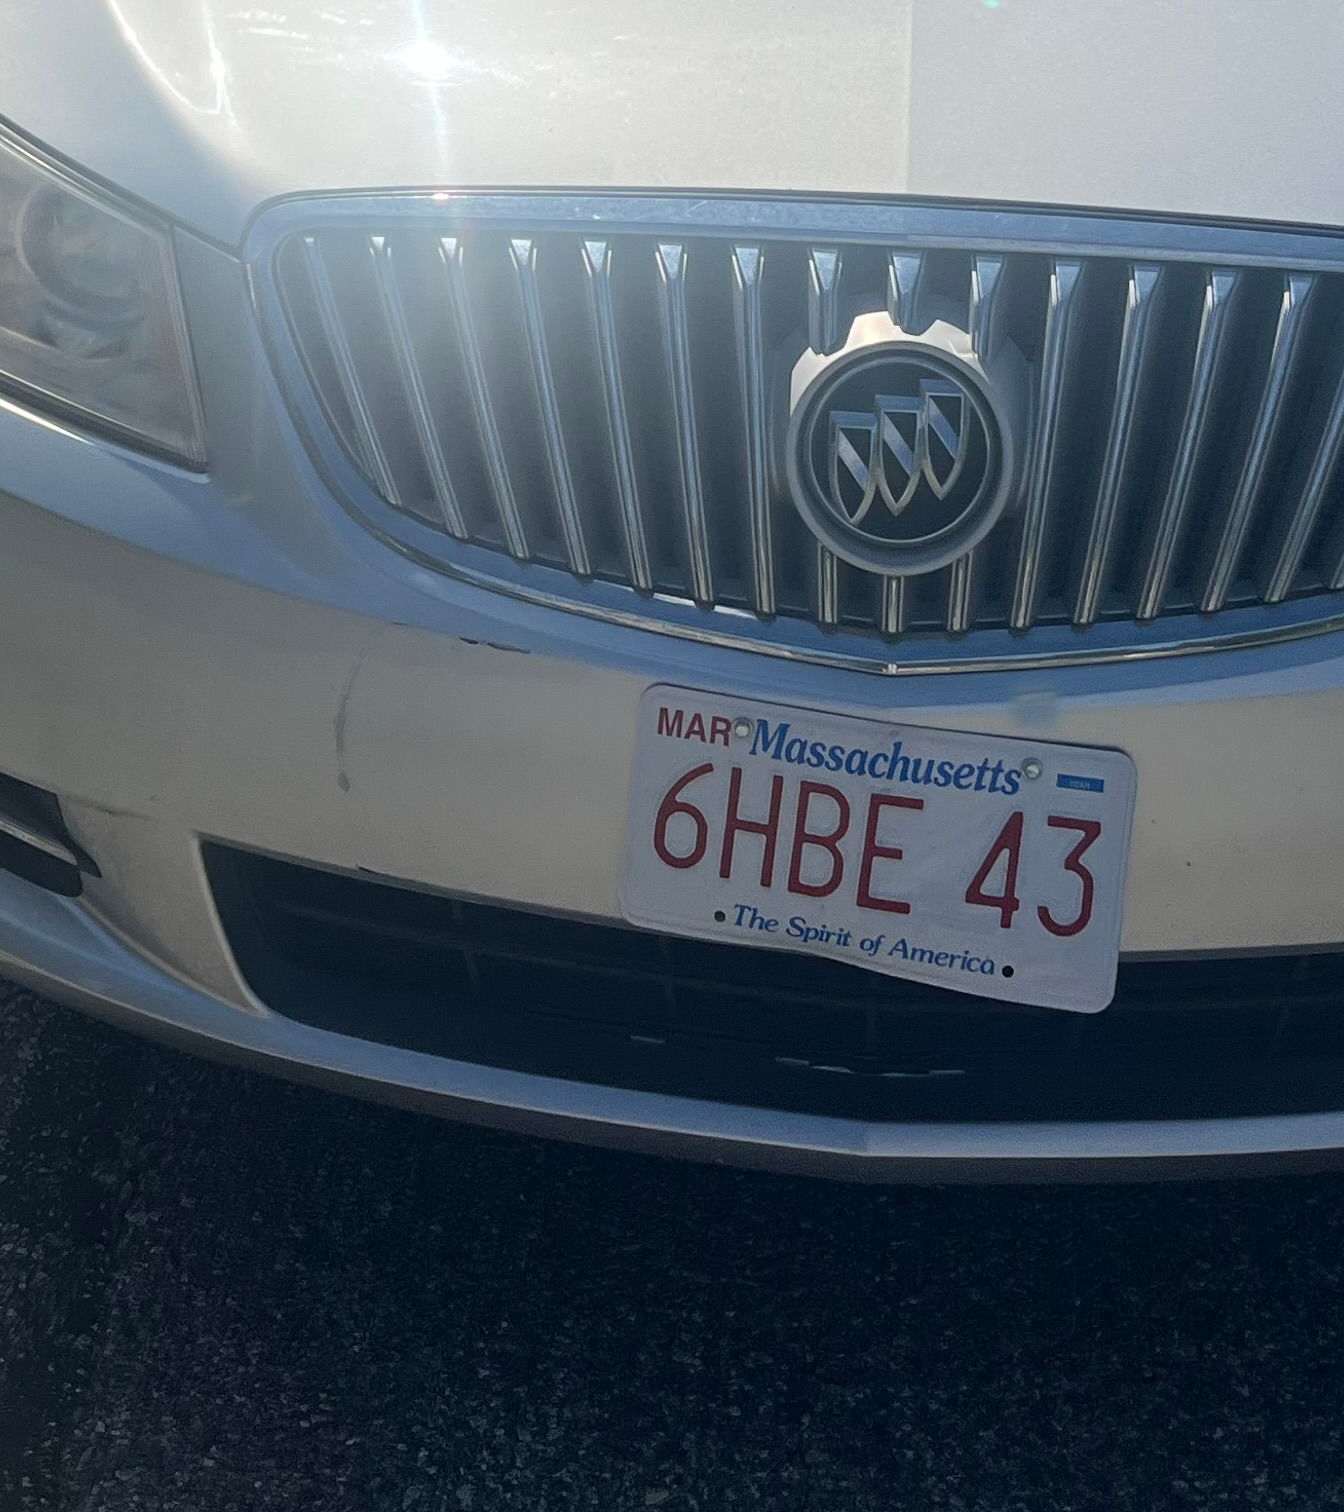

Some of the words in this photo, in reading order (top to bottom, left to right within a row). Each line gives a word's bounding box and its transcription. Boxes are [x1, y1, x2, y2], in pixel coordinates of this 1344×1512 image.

[657, 706, 731, 747] MAR
[749, 718, 1022, 796] Massachusetts
[653, 762, 924, 915] 6HBE
[964, 811, 1102, 937] 43
[734, 904, 779, 933] The
[785, 916, 851, 948] Spirit
[859, 934, 885, 958] of
[888, 937, 996, 976] America
